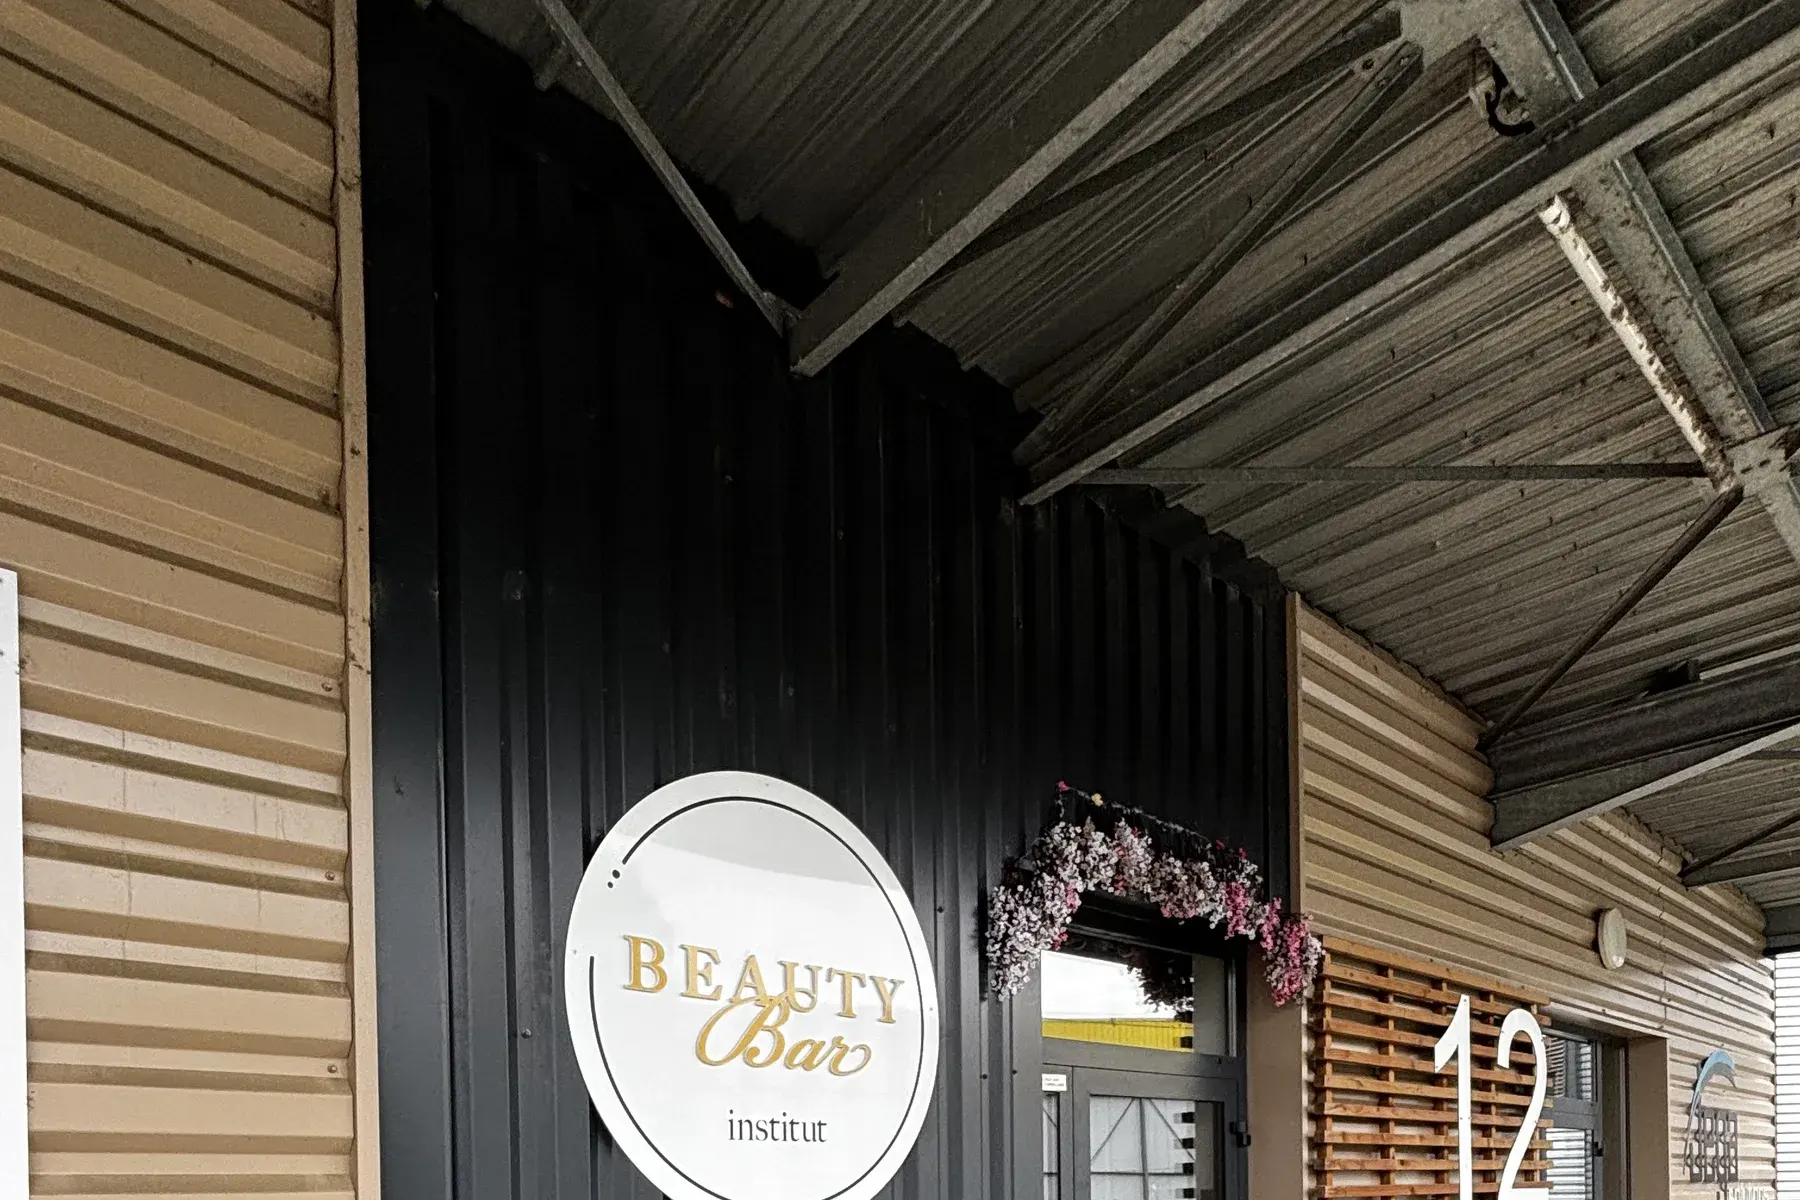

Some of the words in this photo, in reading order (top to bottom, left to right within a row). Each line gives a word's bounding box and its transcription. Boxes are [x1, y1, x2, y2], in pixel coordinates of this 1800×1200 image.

[624, 934, 905, 1023] BEAUTY
[695, 991, 872, 1077] Bar
[728, 1109, 828, 1143] institut
